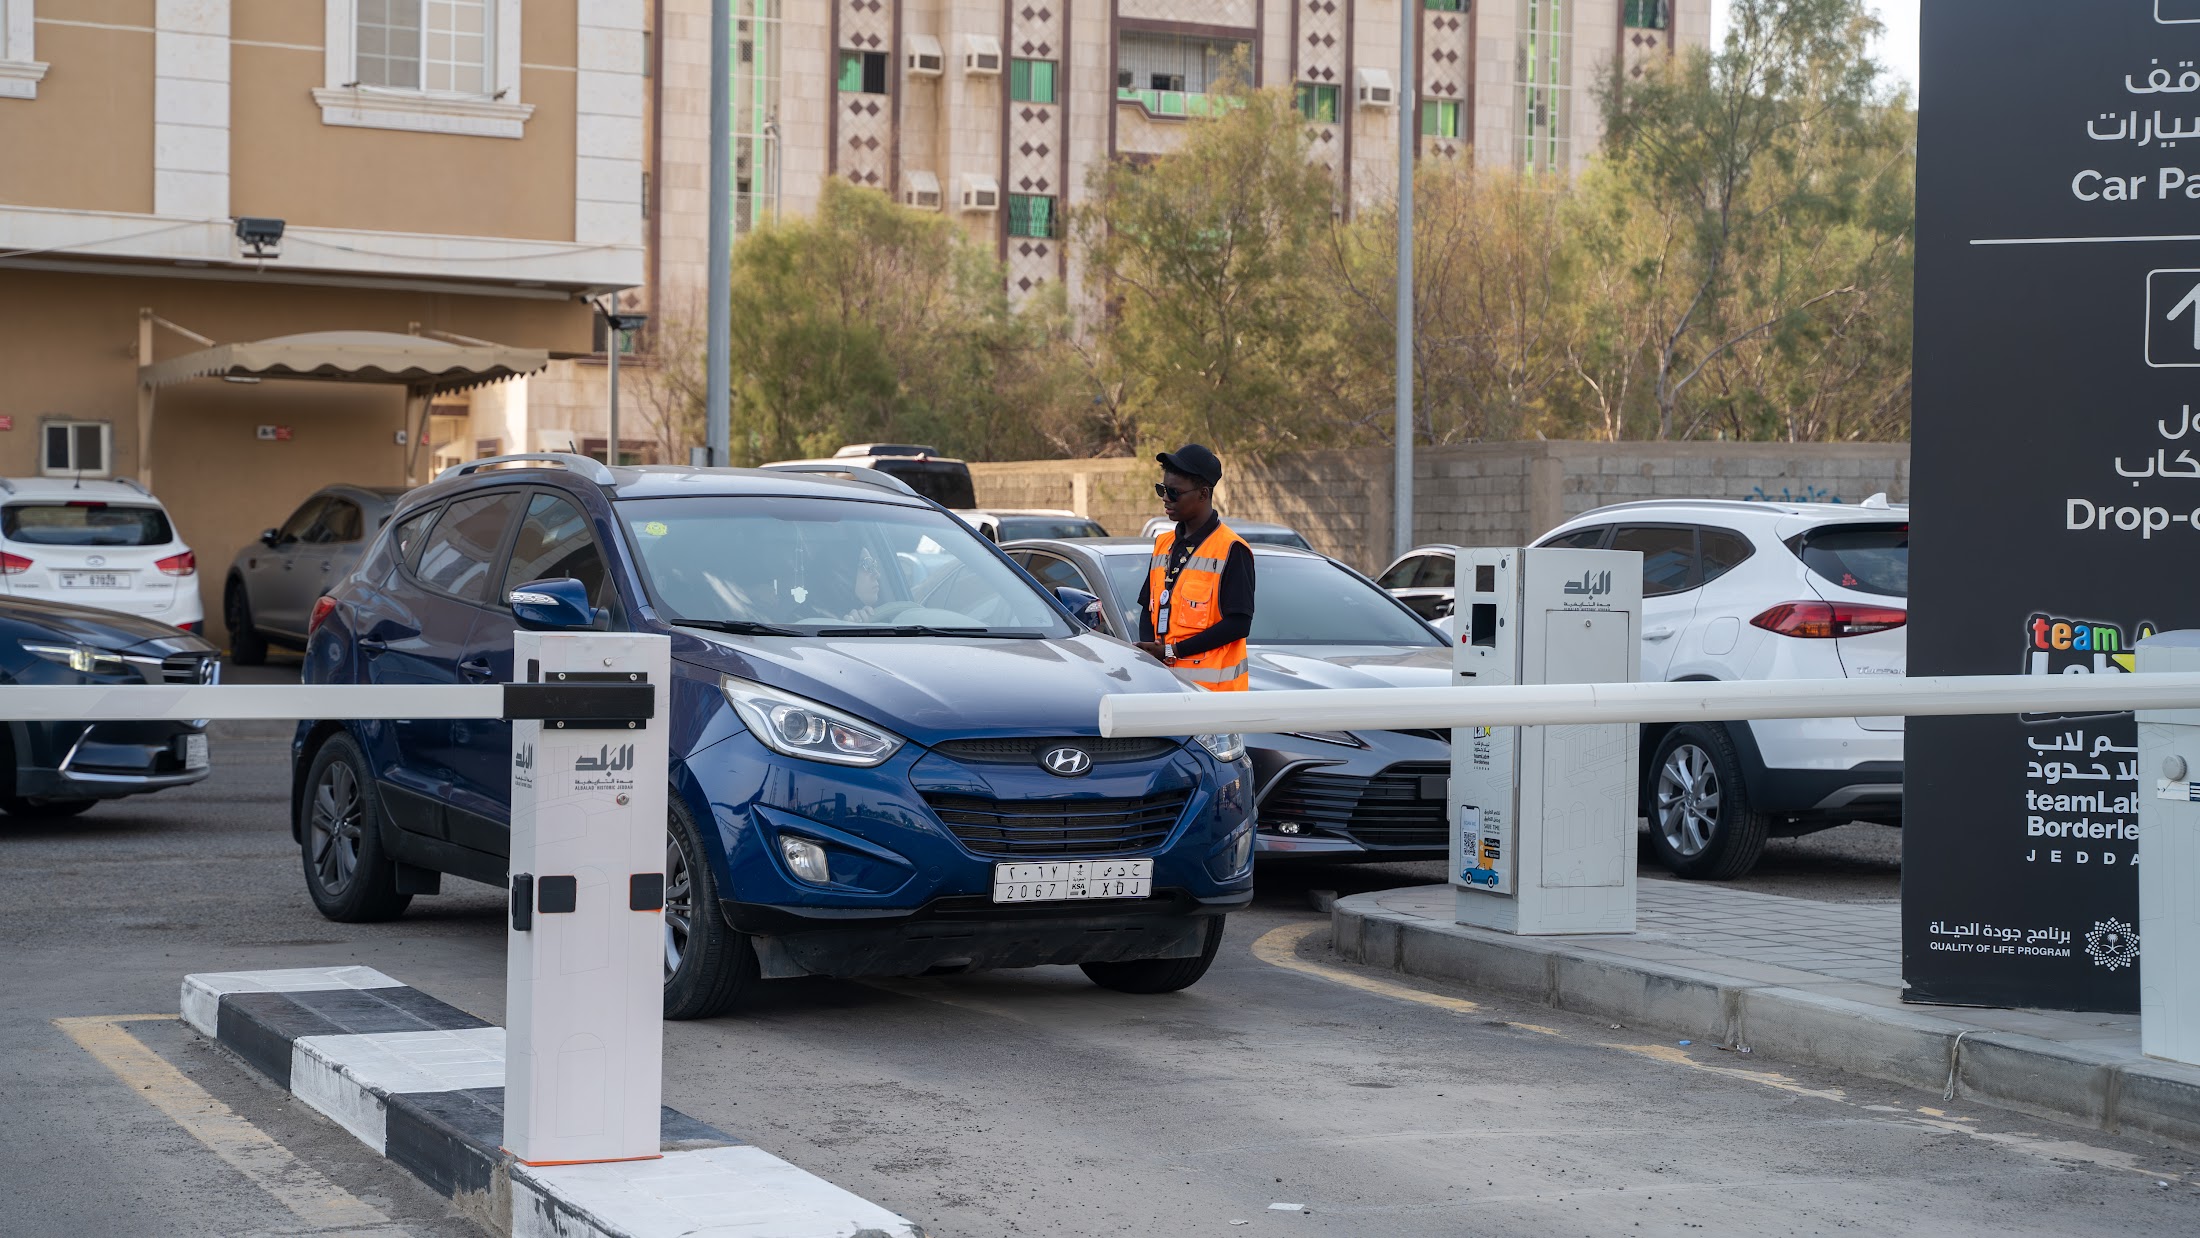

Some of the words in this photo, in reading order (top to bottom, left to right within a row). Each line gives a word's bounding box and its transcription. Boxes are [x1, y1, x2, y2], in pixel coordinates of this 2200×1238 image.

[2072, 169, 2147, 202] Car
[2032, 618, 2118, 652] team
[2027, 730, 2083, 757] لاب
[2026, 761, 2111, 785] حدود
[1007, 883, 1056, 899] 2067
[1102, 881, 1139, 896] XDJ
[1929, 920, 1980, 938] الحياة
[1982, 924, 2022, 942] جودة
[2026, 926, 2071, 945] برنامج
[1929, 941, 1974, 953] QUALITY
[1976, 944, 1991, 953] OF
[1992, 945, 2015, 955] LIFE
[2017, 946, 2071, 958] PROGRAM
